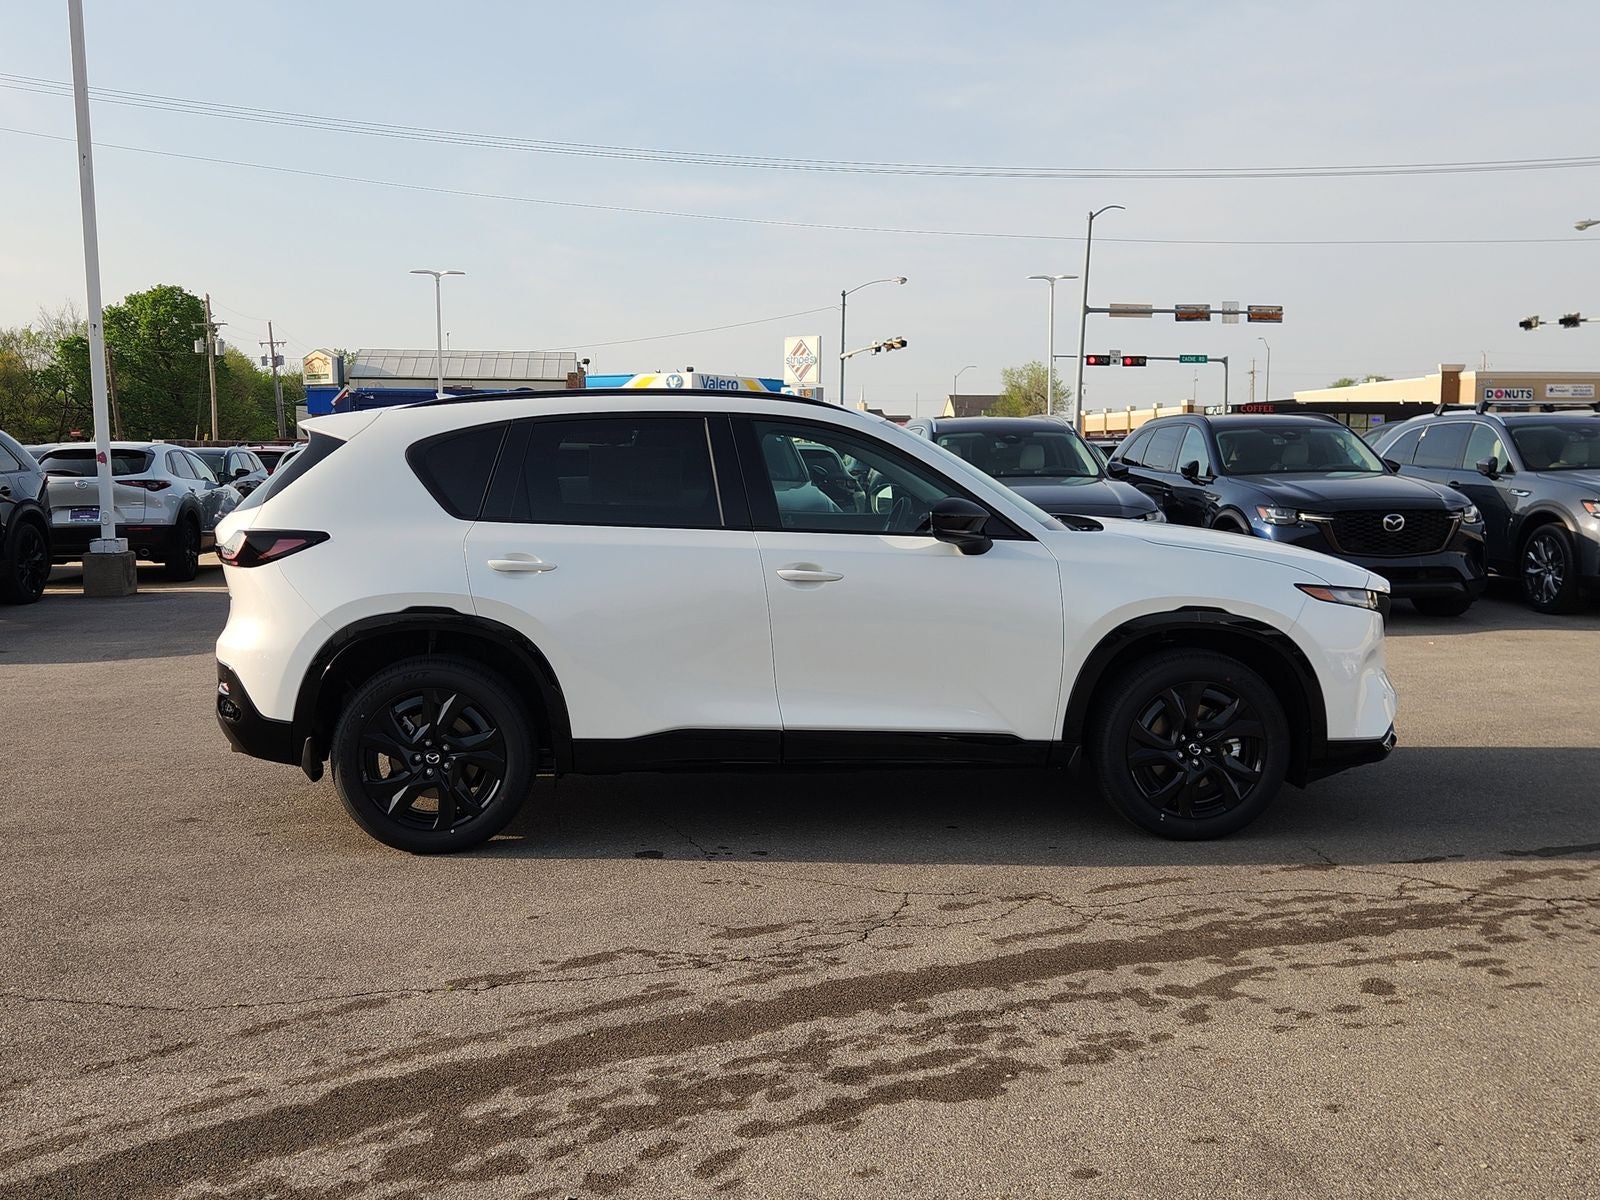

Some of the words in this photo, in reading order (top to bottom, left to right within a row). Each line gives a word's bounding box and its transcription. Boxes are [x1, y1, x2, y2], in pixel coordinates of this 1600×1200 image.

[701, 375, 739, 390] Valero
[1486, 389, 1532, 399] DONUTS
[1240, 404, 1274, 413] COFFEE
